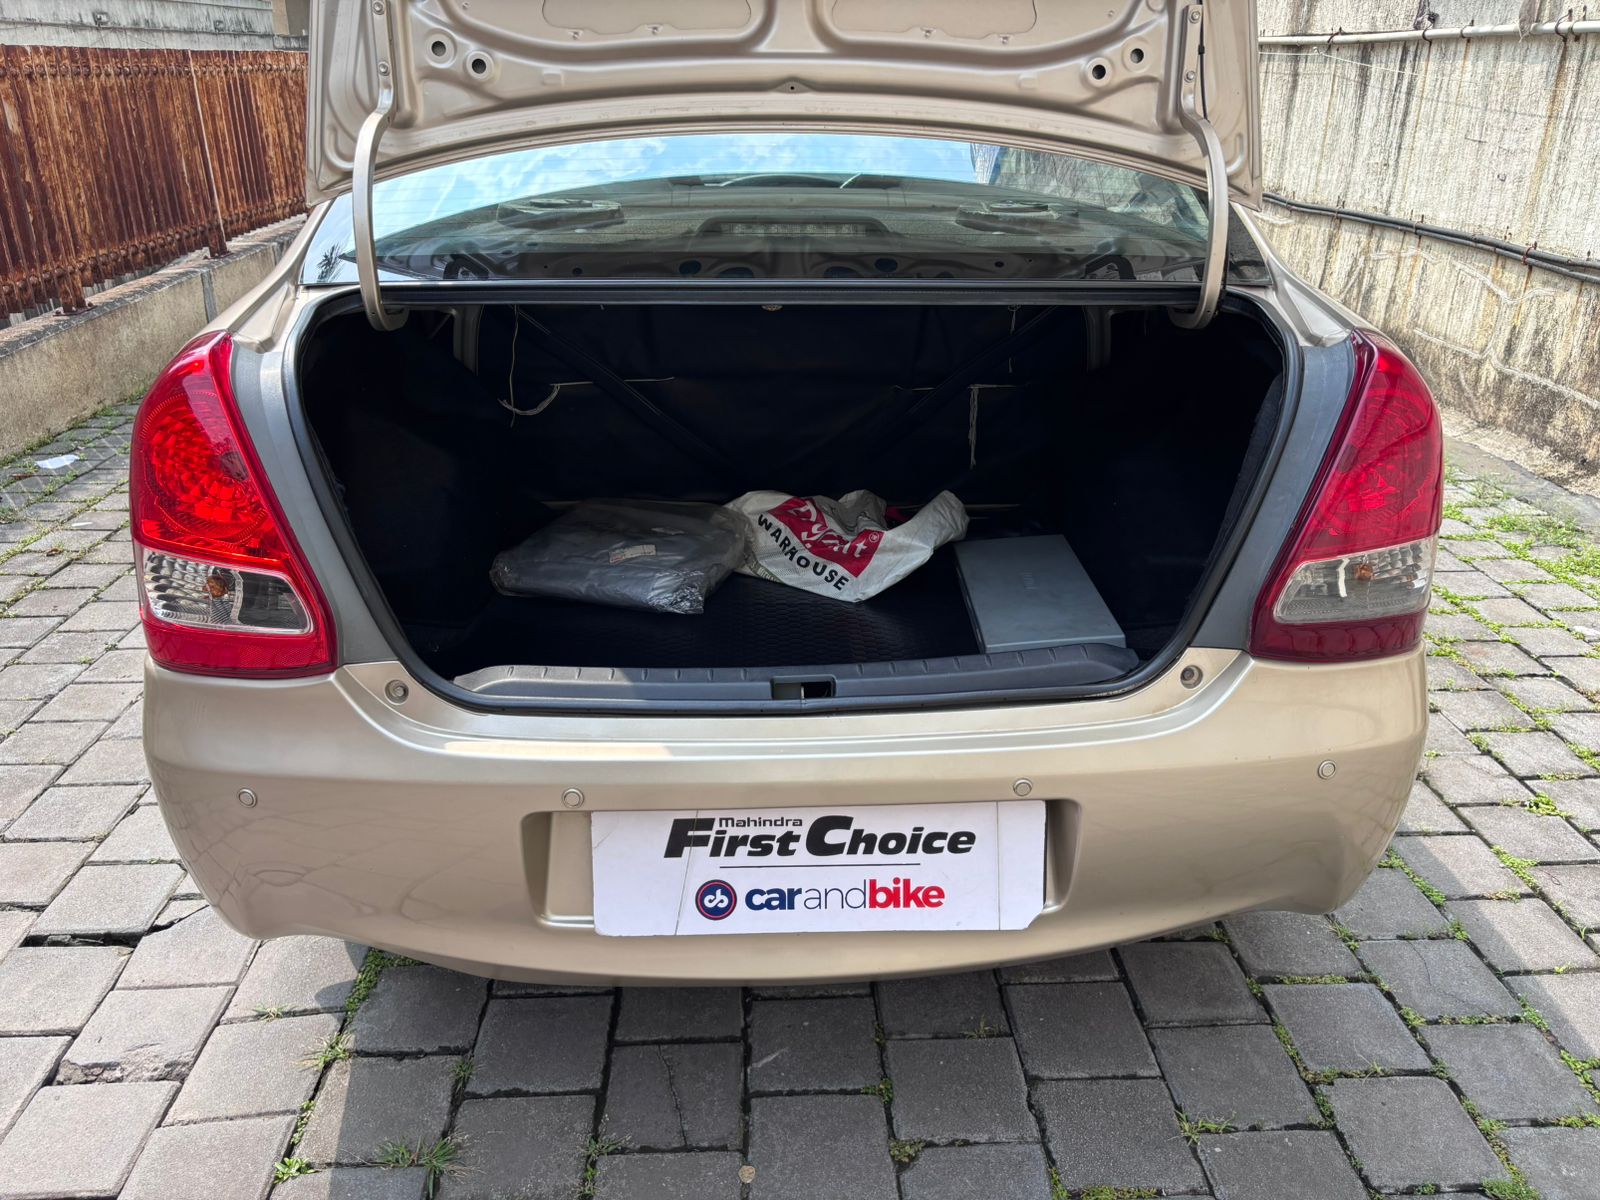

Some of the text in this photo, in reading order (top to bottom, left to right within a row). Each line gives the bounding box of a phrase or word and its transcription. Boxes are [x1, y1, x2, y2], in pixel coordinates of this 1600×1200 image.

[719, 817, 803, 828] Mahindra
[664, 815, 976, 858] First Choice
